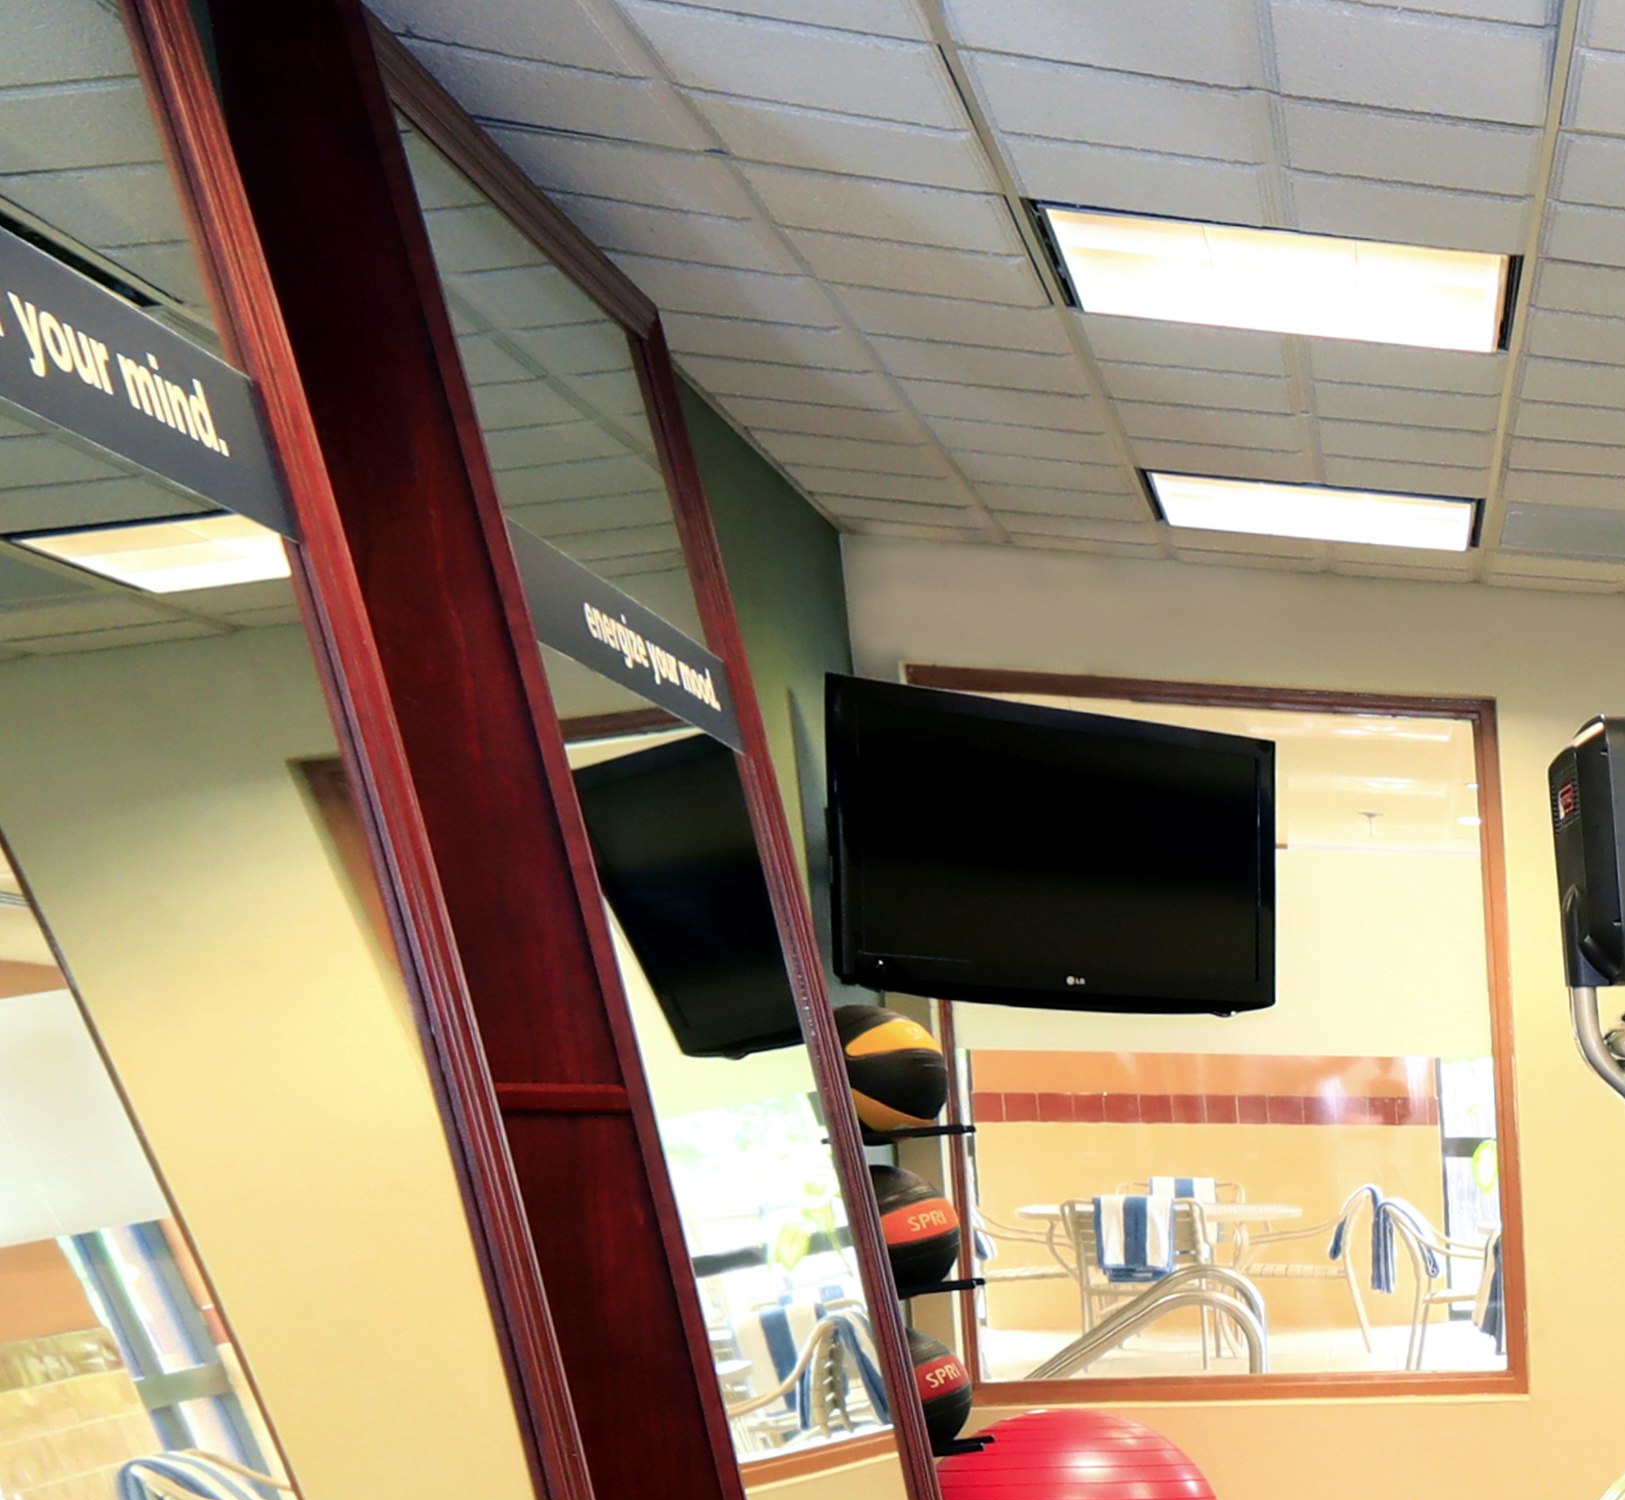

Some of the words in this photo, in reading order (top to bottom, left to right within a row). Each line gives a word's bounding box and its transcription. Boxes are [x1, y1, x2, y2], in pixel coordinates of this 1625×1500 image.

[7, 290, 115, 396] your
[116, 352, 230, 458] mind.
[583, 601, 650, 670] energize
[645, 639, 681, 686] your
[677, 659, 722, 712] mood.
[907, 1209, 948, 1233] SPRI
[924, 1362, 962, 1390] SPRI
